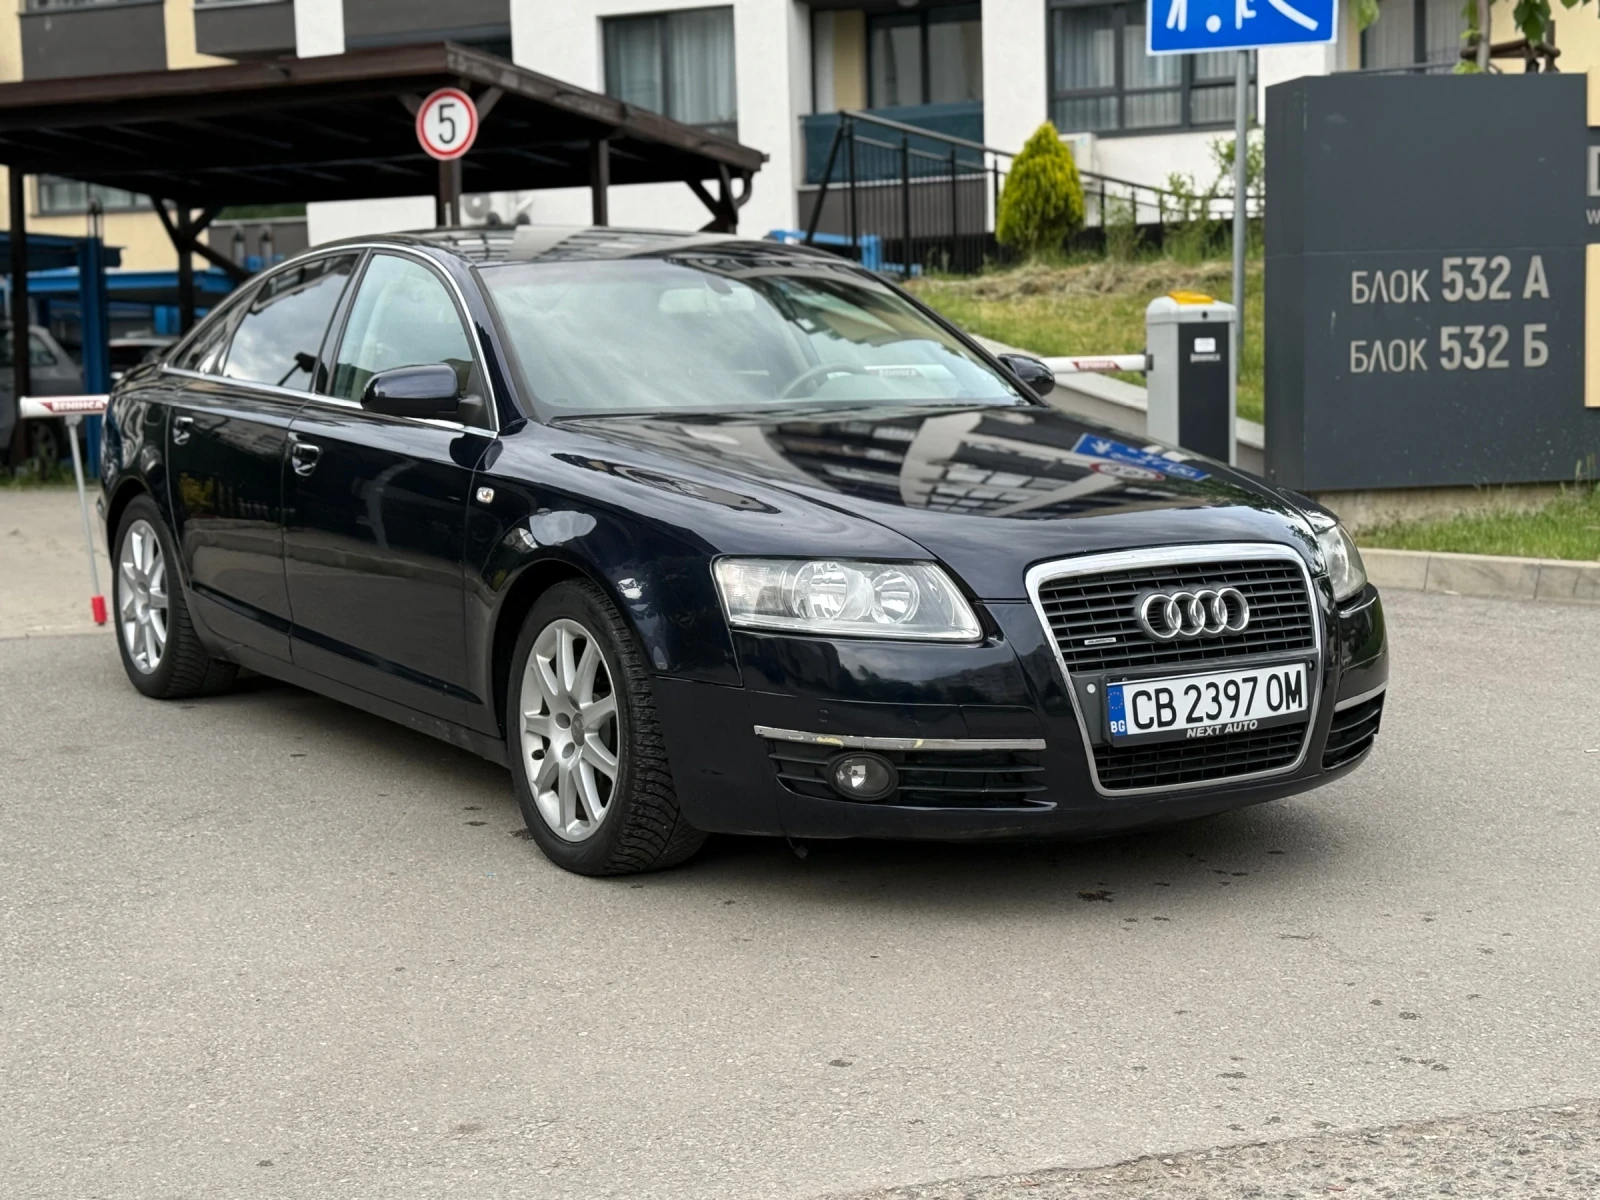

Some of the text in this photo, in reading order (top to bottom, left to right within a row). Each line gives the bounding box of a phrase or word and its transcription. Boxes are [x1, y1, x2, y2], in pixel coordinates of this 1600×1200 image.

[439, 103, 456, 145] 5
[1351, 255, 1550, 304] БЛОК 532 А
[1350, 323, 1549, 373] БЛОК 532 Б
[1131, 670, 1303, 731] CB 2397 OM
[1110, 720, 1126, 734] BG
[1186, 719, 1258, 739] NEXT AUTO
